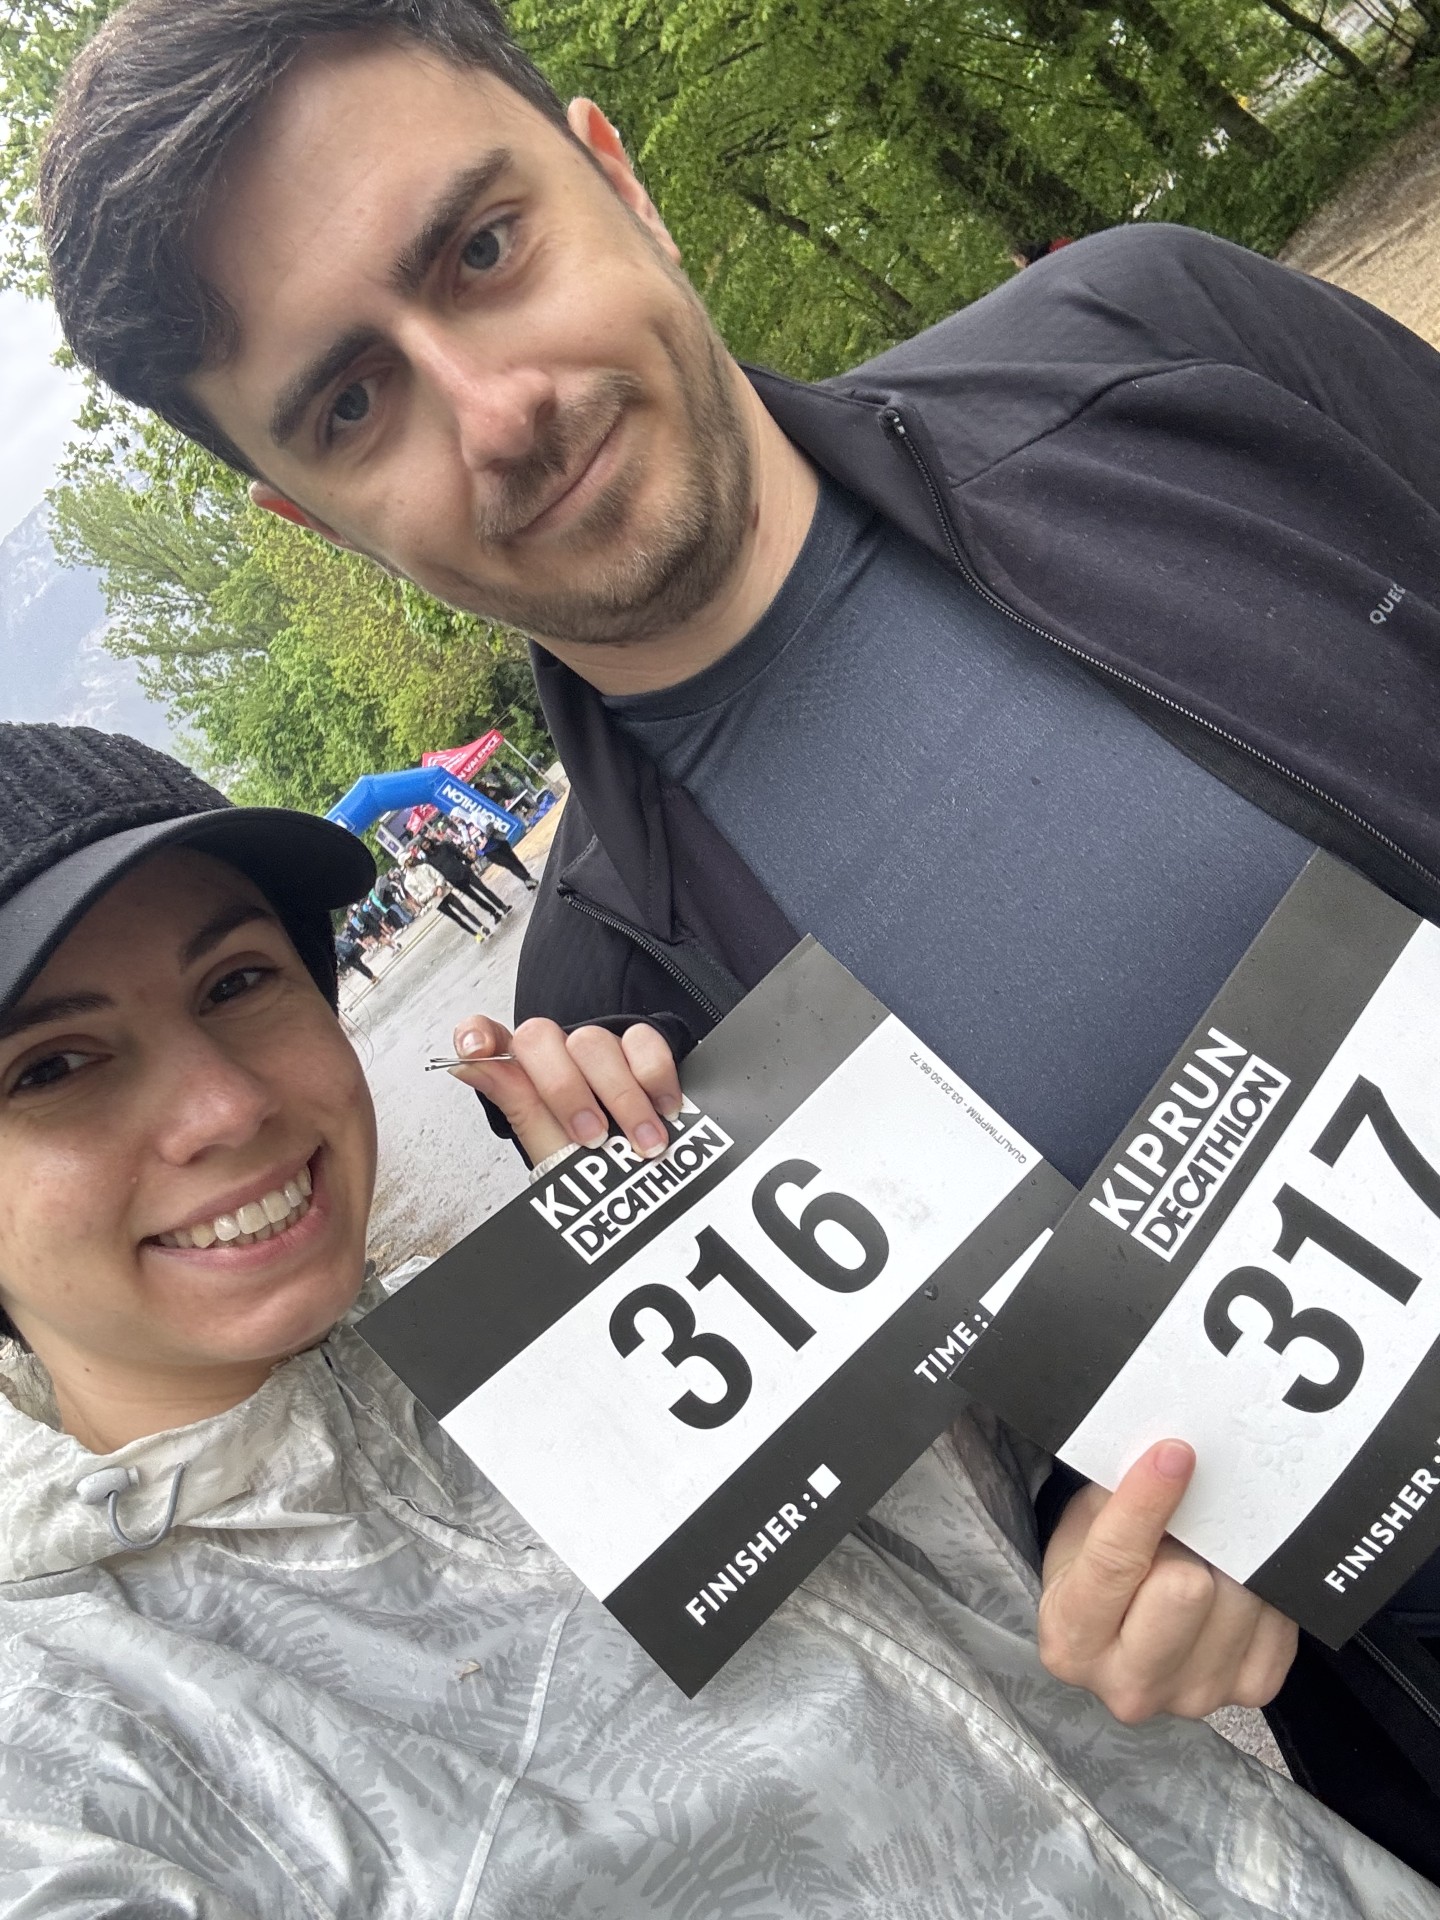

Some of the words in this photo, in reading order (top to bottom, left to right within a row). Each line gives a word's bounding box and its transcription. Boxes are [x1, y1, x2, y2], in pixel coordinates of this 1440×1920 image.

[442, 784, 511, 833] DECTHLON
[529, 1093, 701, 1230] KIPR
[571, 1124, 726, 1256] DECATHLON
[1088, 1027, 1248, 1231] KIPRUN
[1141, 1065, 1283, 1252] DECATHLON
[609, 1158, 890, 1430] 316
[1203, 1074, 1440, 1413] 317
